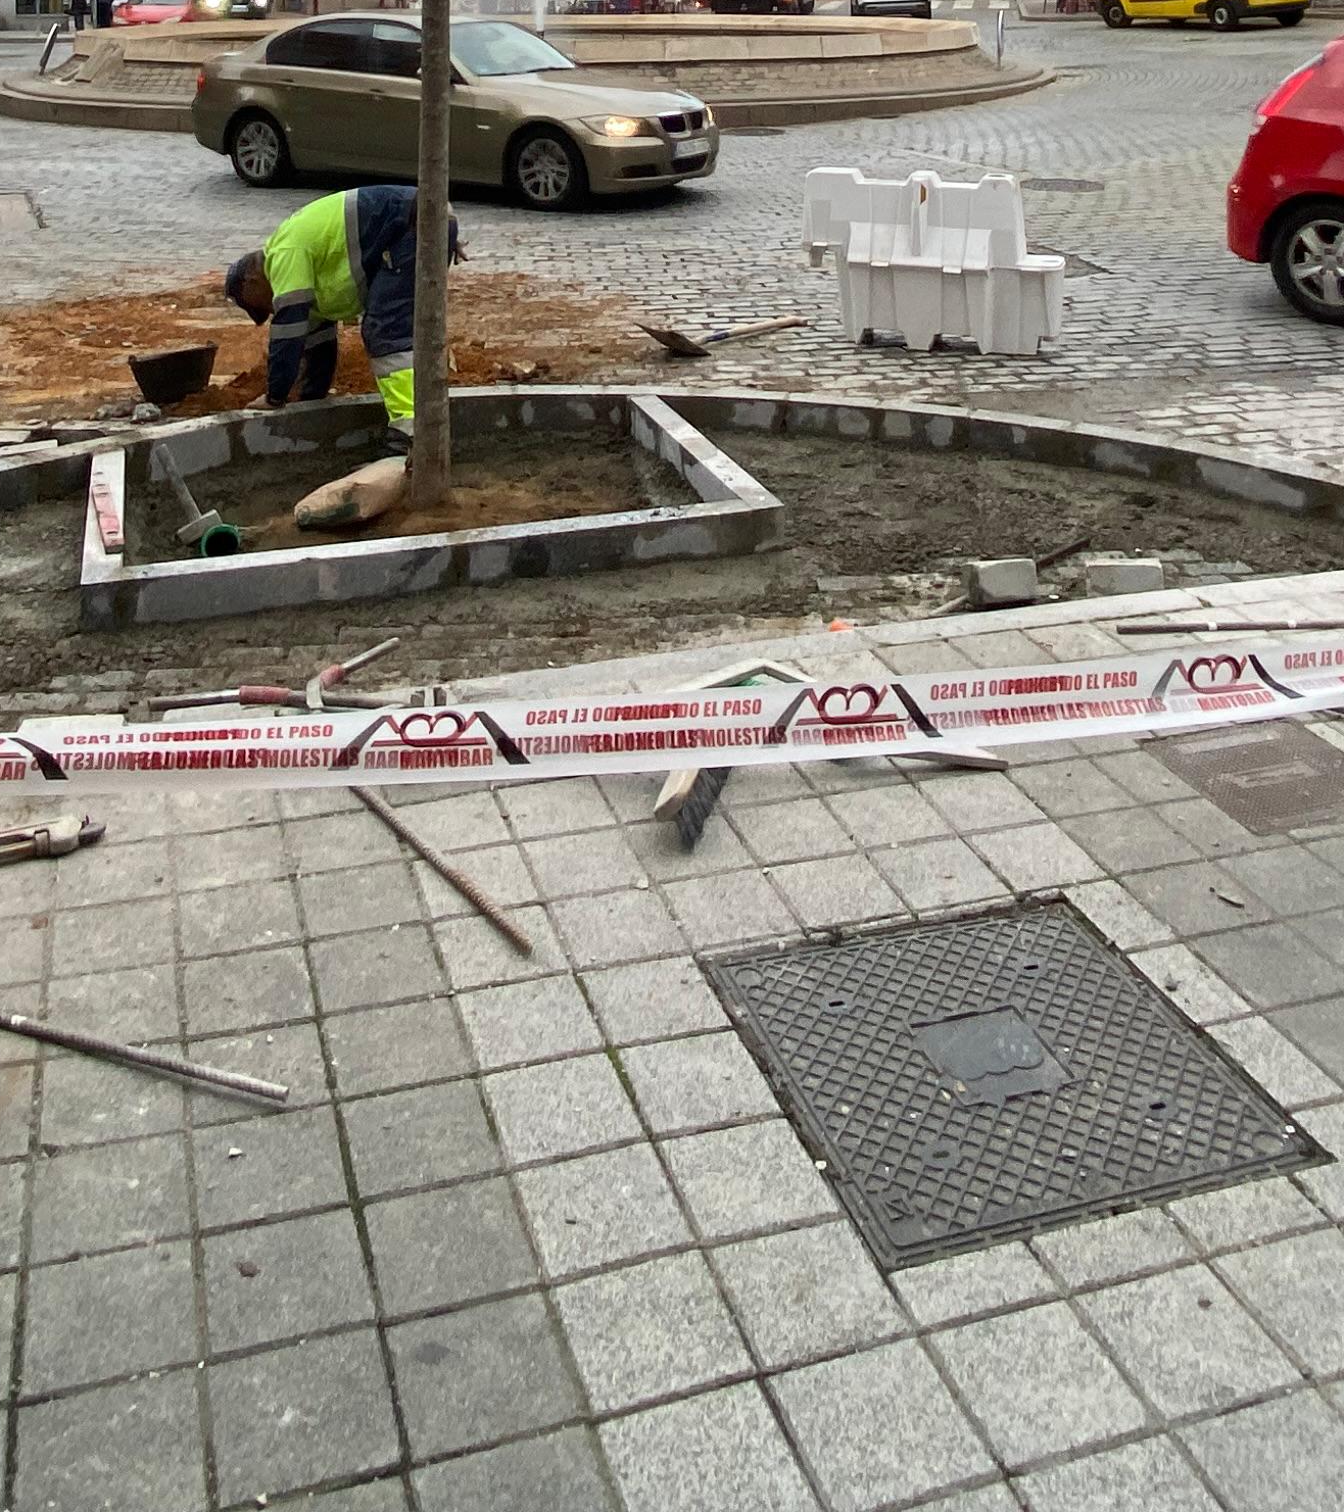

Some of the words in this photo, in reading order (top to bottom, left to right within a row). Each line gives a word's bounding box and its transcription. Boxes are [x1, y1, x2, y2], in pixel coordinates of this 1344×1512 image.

[1087, 673, 1100, 690] EL
[1104, 671, 1138, 688] PASO
[704, 701, 719, 718] EL
[723, 699, 763, 717] PASO
[267, 727, 284, 739] EL
[289, 724, 334, 738] PASO
